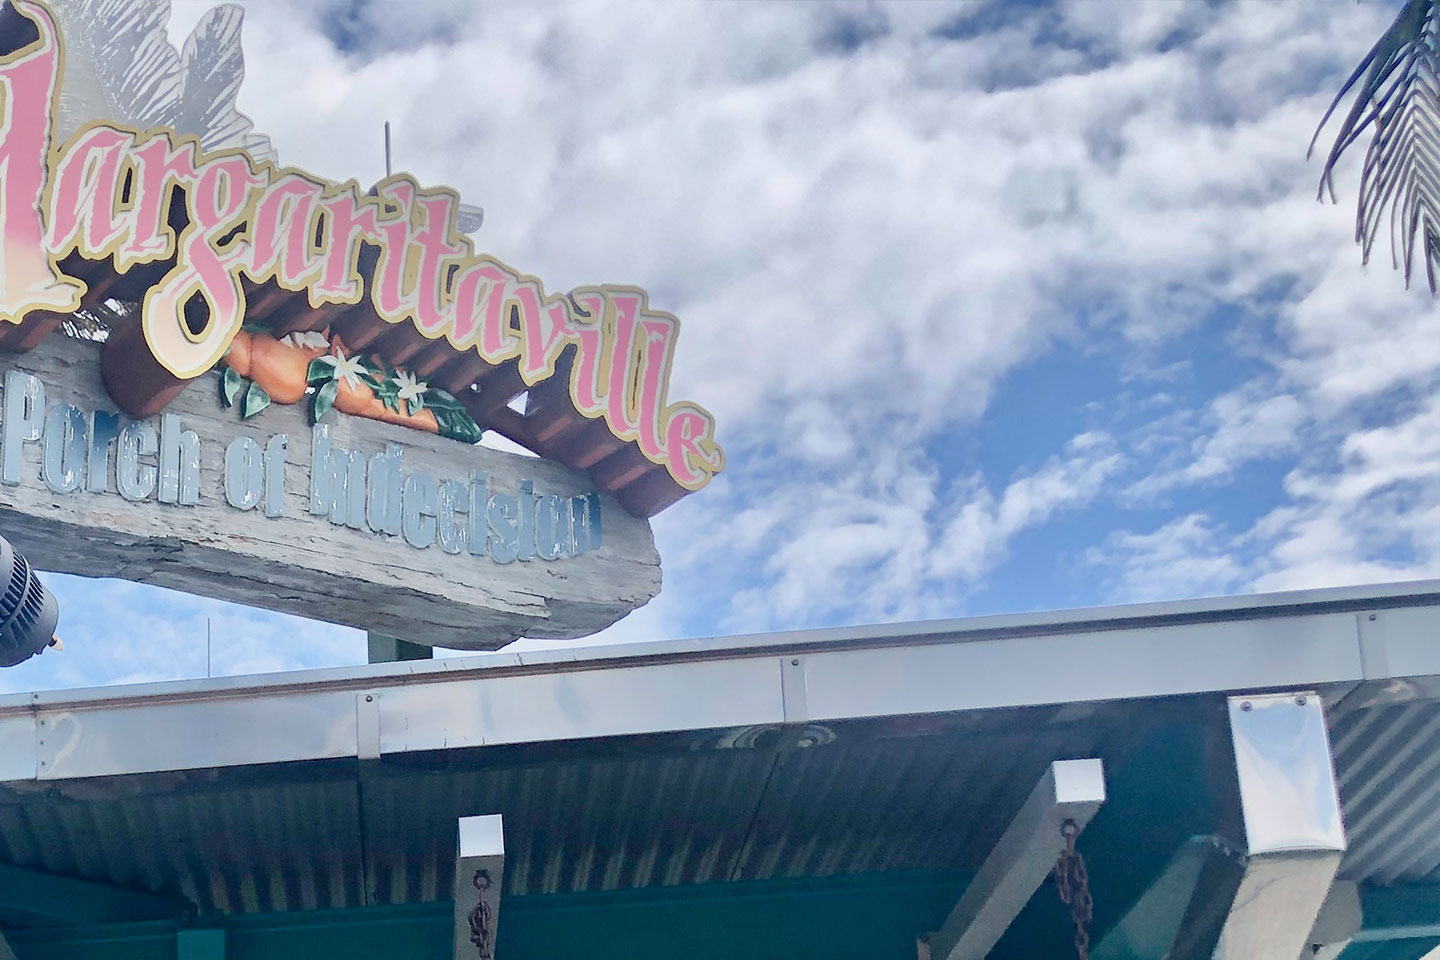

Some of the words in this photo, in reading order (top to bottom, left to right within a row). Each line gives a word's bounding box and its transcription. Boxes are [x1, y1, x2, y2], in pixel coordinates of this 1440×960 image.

[0, 369, 201, 506] Porch
[225, 433, 289, 518] of
[309, 422, 602, 565] Indecision
